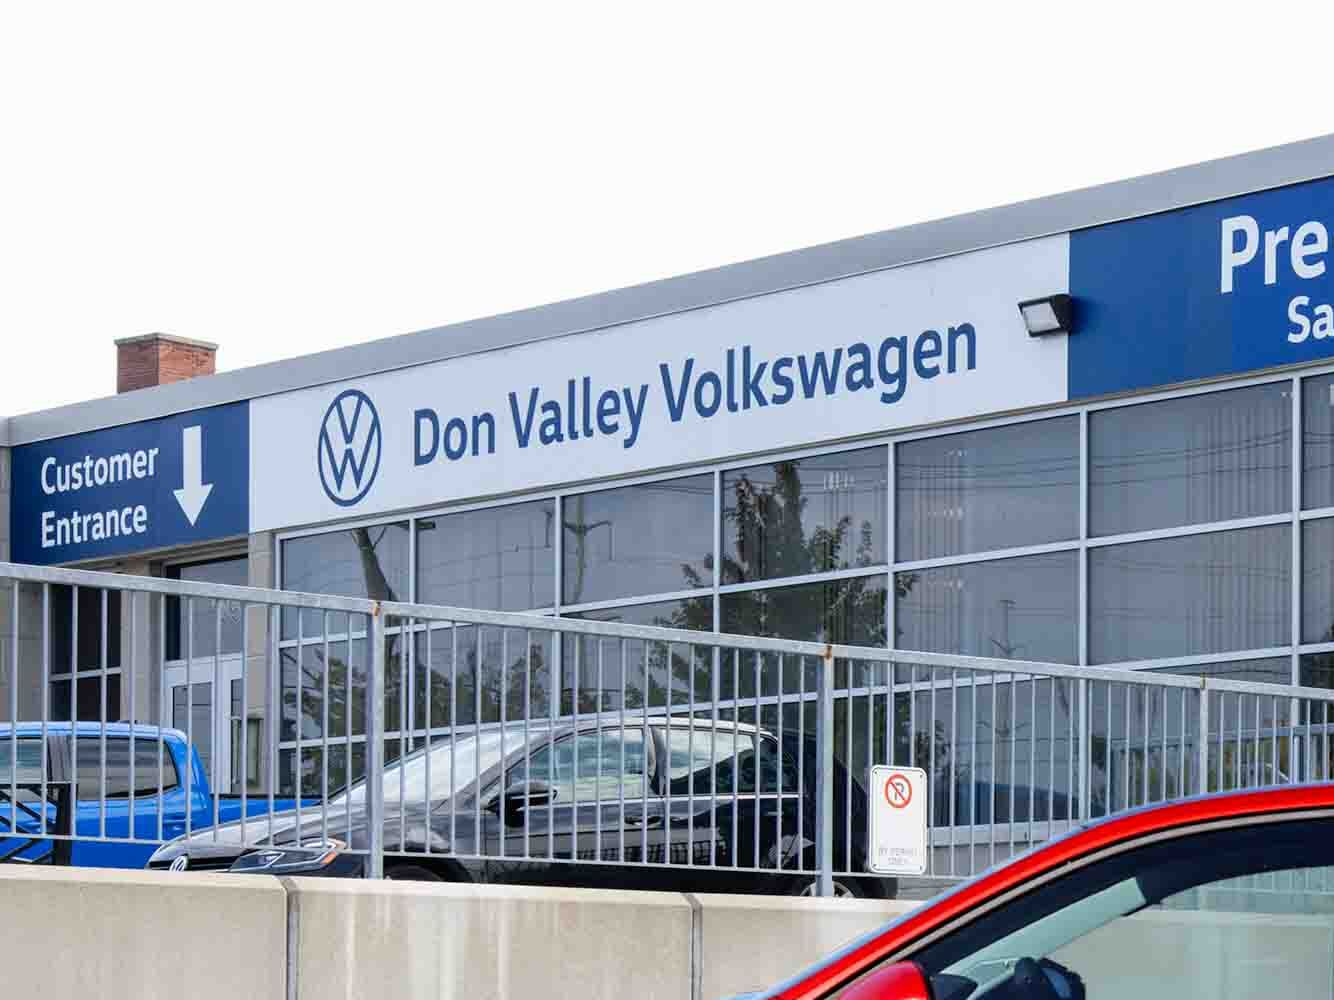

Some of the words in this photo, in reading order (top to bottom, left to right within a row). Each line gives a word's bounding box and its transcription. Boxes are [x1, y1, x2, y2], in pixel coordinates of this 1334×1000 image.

[413, 408, 496, 467] Don
[508, 375, 649, 449] Valley
[659, 322, 977, 423] Volkswagen
[41, 447, 159, 495] Customer
[41, 504, 148, 548] Entrance
